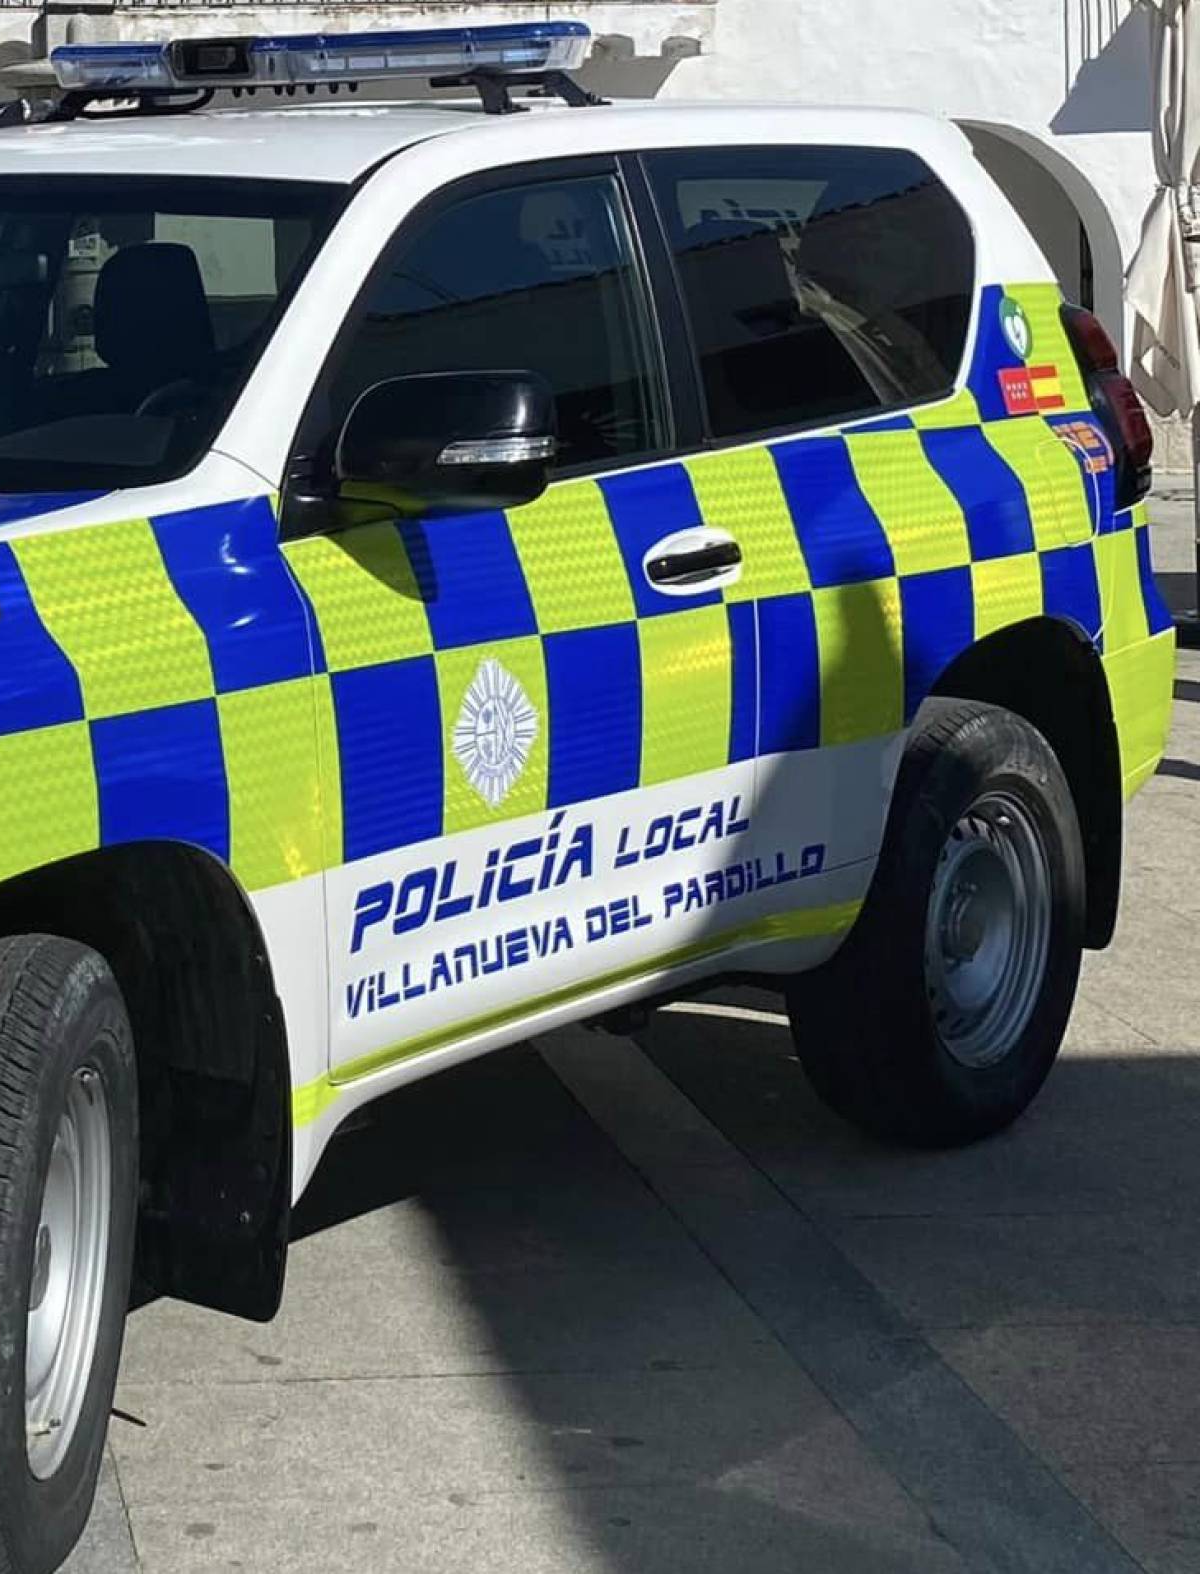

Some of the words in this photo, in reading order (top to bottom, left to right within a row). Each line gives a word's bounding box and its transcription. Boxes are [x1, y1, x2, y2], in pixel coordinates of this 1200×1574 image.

[346, 917, 573, 1018] VILLANUEVA
[586, 895, 652, 941] DEL
[663, 843, 825, 918] PARDILLO
[350, 811, 593, 954] POLICÍA
[614, 796, 750, 869] LOCAL
